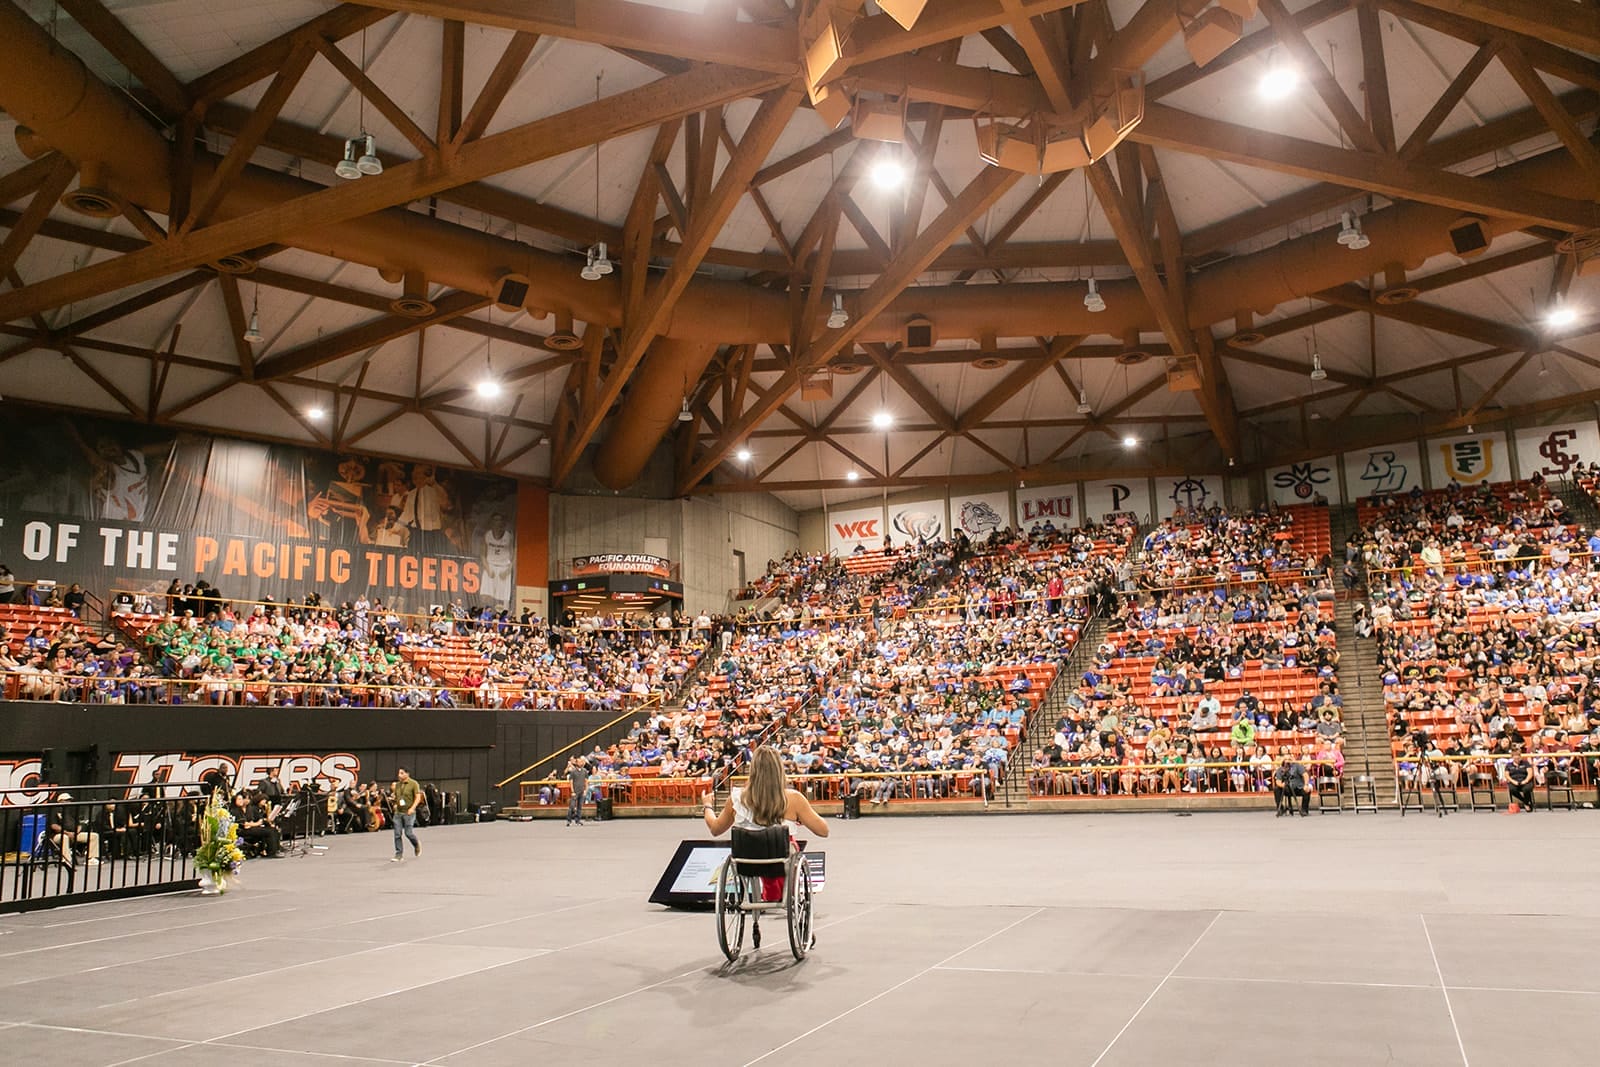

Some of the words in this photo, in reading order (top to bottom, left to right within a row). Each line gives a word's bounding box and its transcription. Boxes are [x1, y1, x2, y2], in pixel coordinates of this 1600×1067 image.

[1022, 496, 1073, 522] LMU
[1104, 484, 1131, 511] P
[834, 519, 879, 539] WCC
[23, 521, 81, 563] OF
[100, 527, 180, 571] THE
[194, 536, 351, 584] PACIFIC
[365, 551, 480, 593] TIGERS
[589, 554, 624, 564] PACIFIC
[624, 554, 660, 565] ATHLETIC
